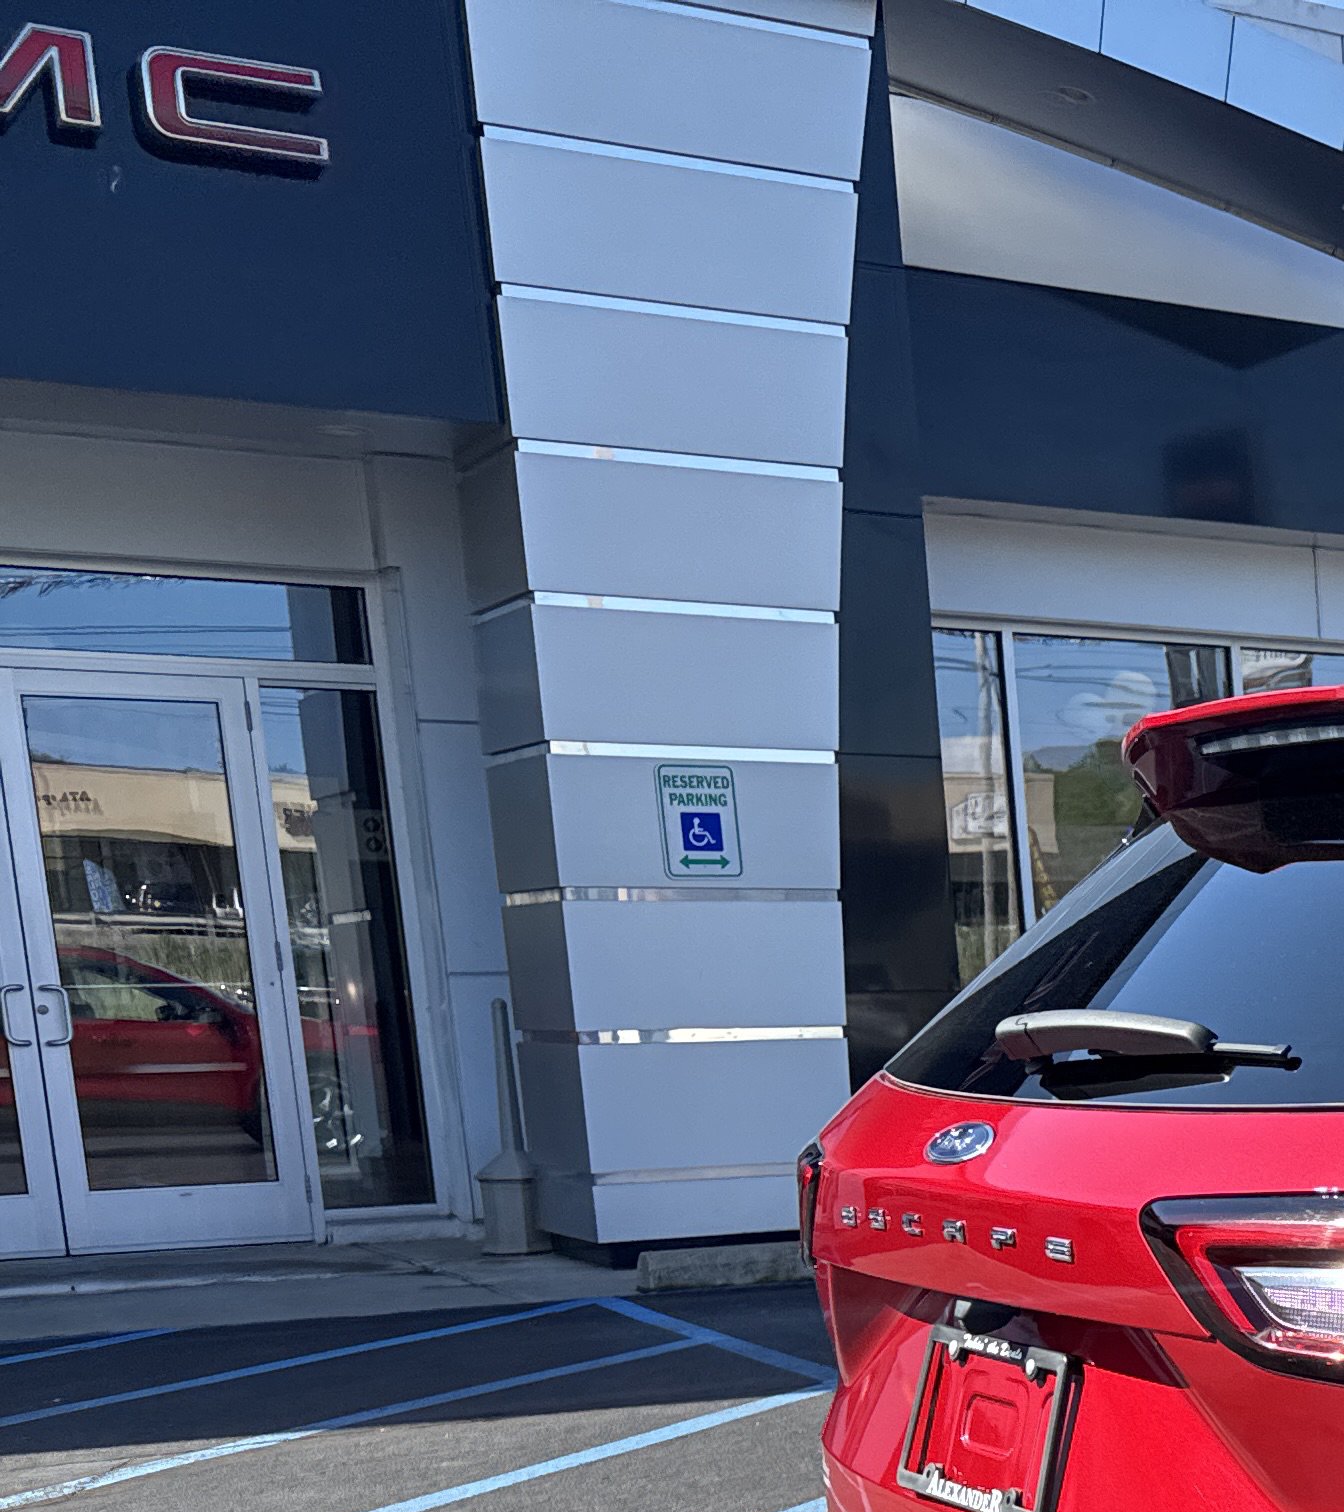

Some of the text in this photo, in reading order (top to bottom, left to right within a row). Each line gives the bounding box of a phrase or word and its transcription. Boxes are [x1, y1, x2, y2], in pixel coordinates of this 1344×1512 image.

[662, 774, 729, 789] RESERVED
[669, 793, 728, 807] PARKING
[841, 1205, 1073, 1264] ESCAPE
